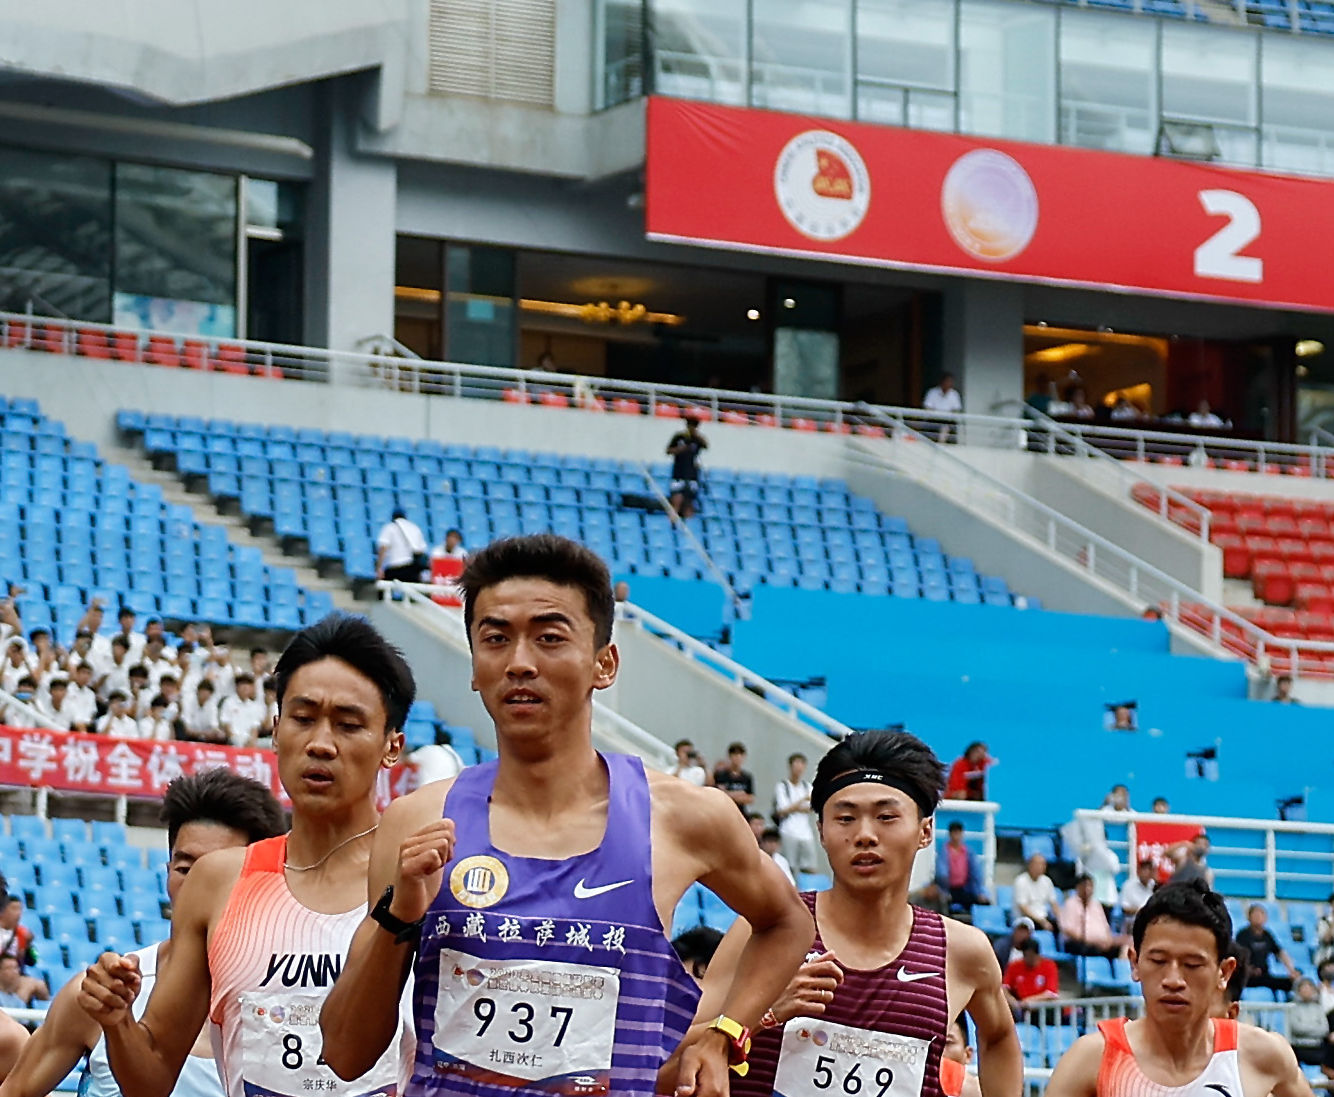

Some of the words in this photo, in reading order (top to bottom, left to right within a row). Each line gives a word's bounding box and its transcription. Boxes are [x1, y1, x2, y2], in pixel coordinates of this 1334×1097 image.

[435, 912, 627, 955] 西藏拉萨城投
[474, 997, 574, 1048] 937
[489, 1049, 544, 1068] 扎西次仁
